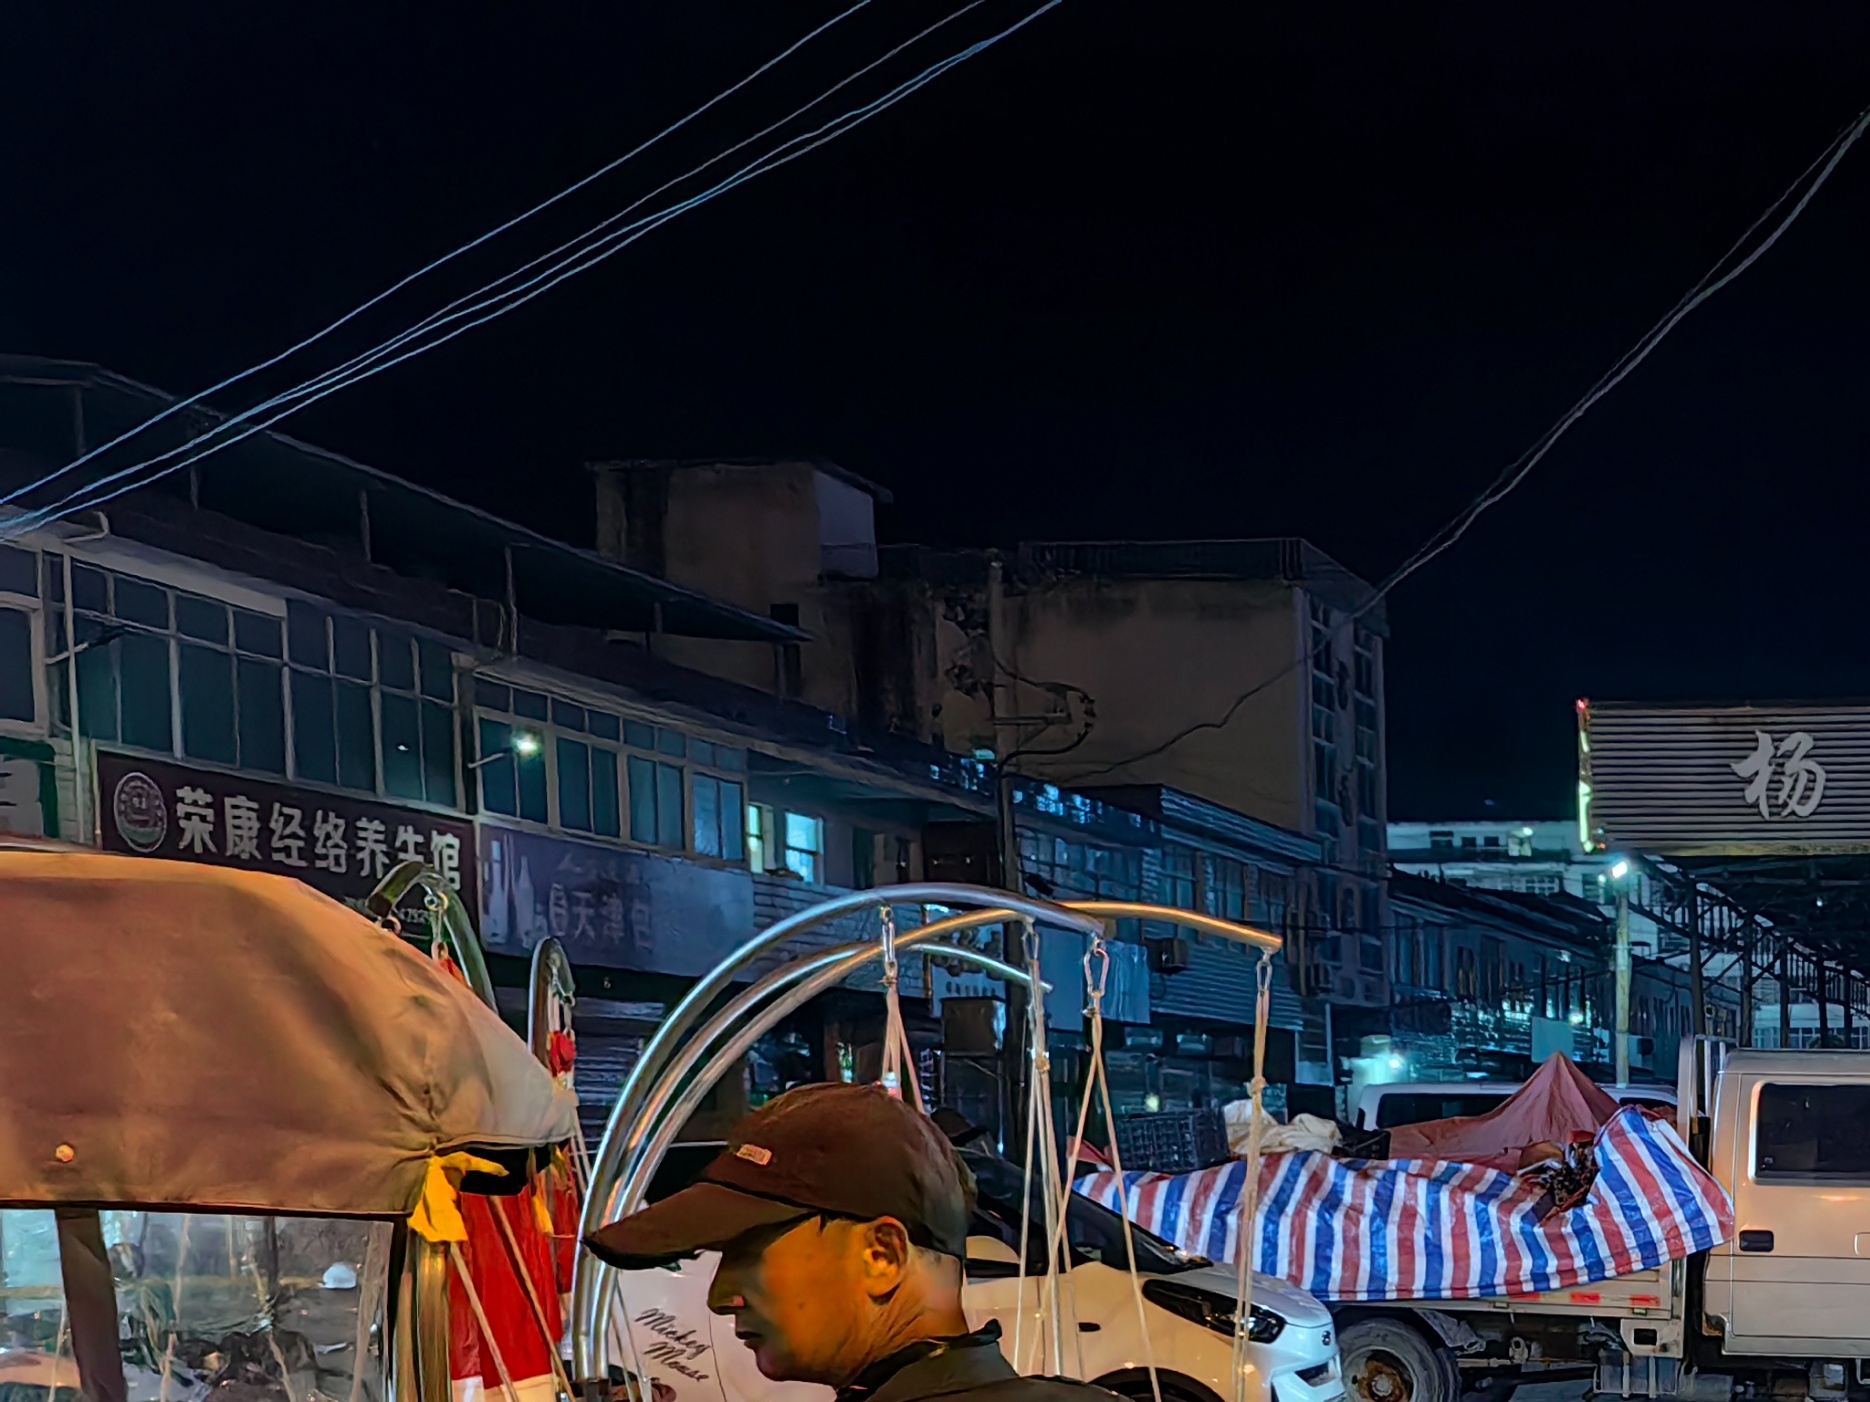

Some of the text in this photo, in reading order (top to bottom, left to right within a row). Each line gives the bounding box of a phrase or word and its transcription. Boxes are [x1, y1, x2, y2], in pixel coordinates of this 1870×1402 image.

[175, 786, 461, 891] 荣康经络养生馆
[635, 1308, 711, 1360] Mickey
[644, 1341, 709, 1382] Mouse
